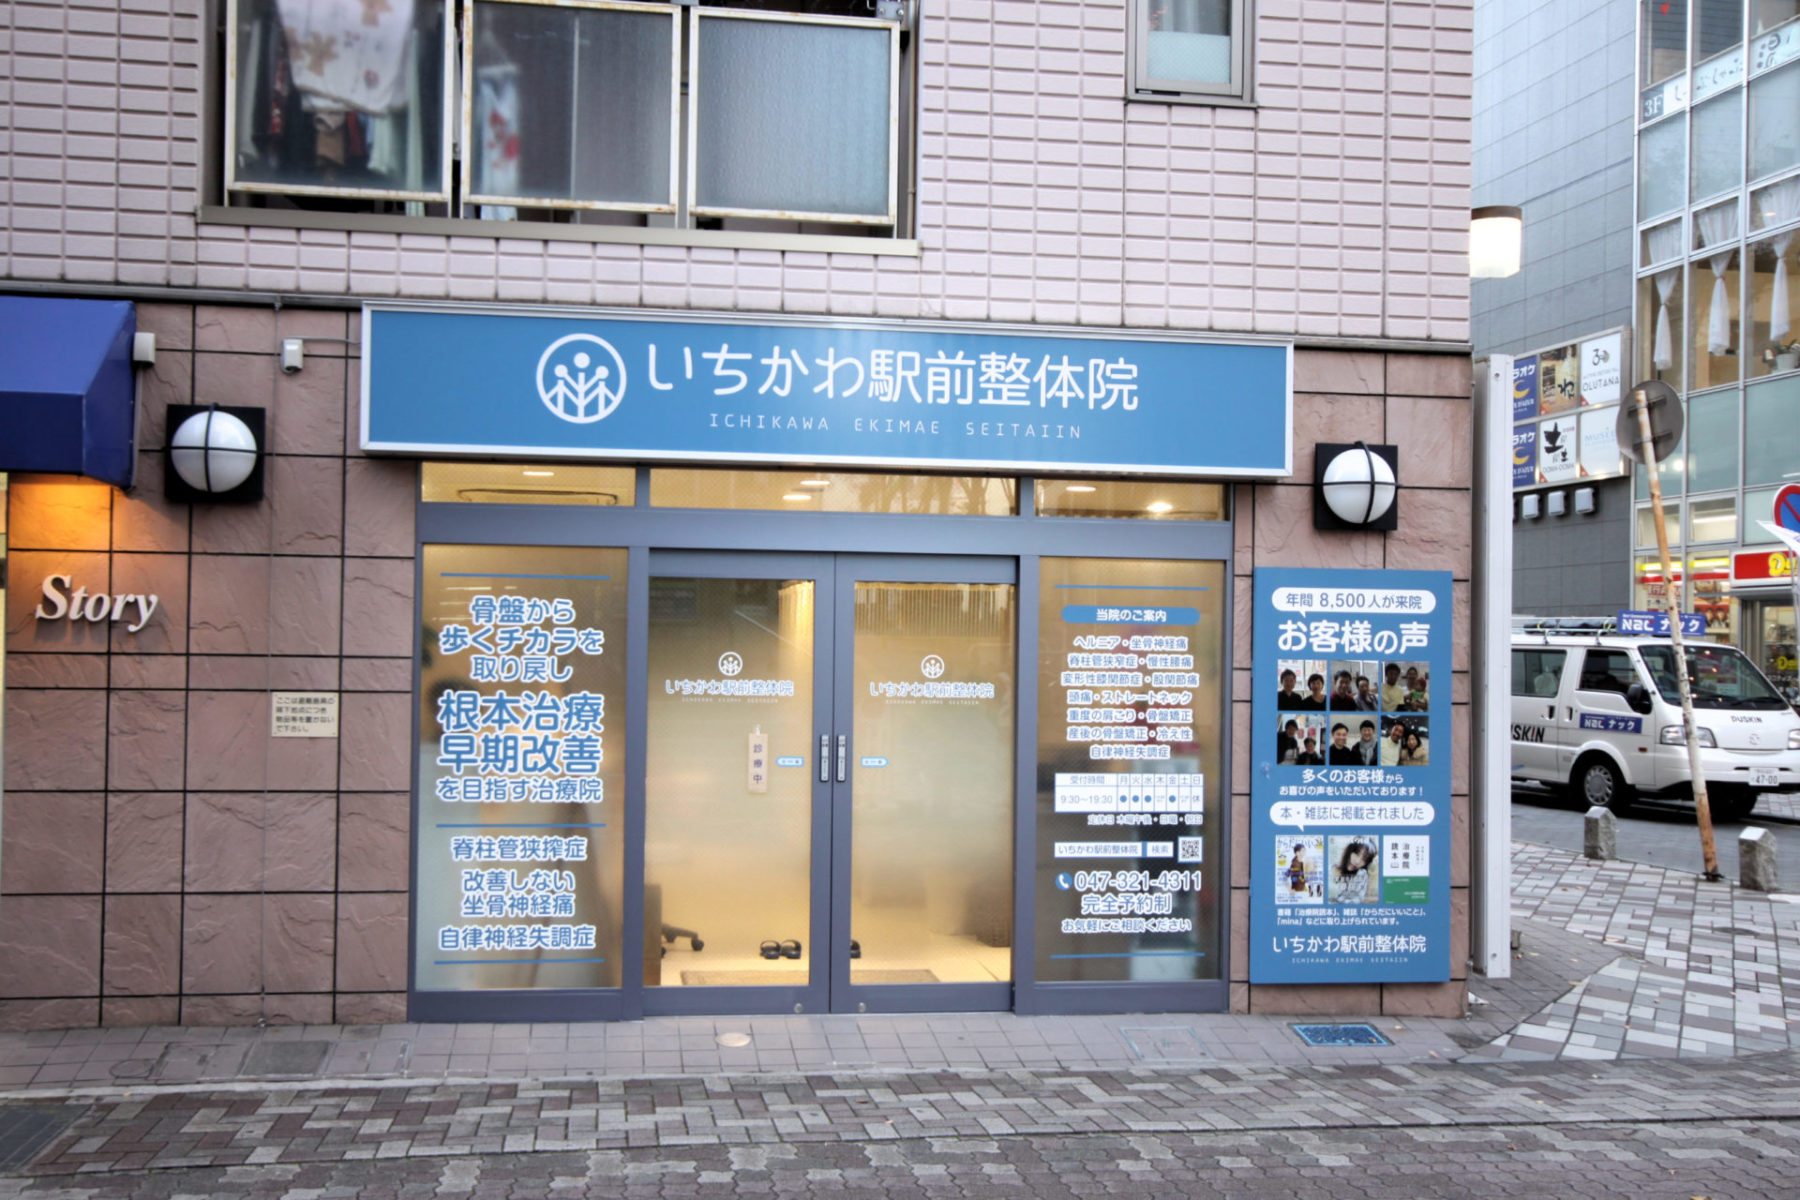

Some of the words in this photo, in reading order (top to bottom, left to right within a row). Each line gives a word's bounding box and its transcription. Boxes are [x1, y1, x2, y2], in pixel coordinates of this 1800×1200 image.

[1644, 94, 1663, 118] 3F
[648, 342, 1139, 411] いちかわ駅前整体院
[709, 413, 829, 431] ICHIKAWA
[854, 417, 940, 434] EKIMAE
[965, 421, 1080, 439] SEITAIIN
[35, 574, 159, 632] Story
[1286, 592, 1314, 608] 年間
[1319, 592, 1423, 609] 8,500人が来院
[471, 597, 576, 624] 骨盤から
[1096, 609, 1167, 622] 当院のご案内
[440, 627, 605, 655] 歩くチカラを
[1073, 635, 1188, 651] ヘルニア・坐骨神経痛
[1277, 619, 1431, 655] お客様の声
[471, 656, 574, 682] 取り戻し
[665, 679, 795, 696] いちかわ駅前整体院
[869, 681, 995, 698] いちかわ駅前整体院
[1067, 690, 1192, 704] 頭痛・ストレートネック
[437, 690, 605, 733] 根本治療
[1067, 708, 1193, 723] 重度の肩こり・骨盤矯正
[1066, 727, 1193, 742] 産後の骨盤矯正・冷え性
[1609, 720, 1635, 730] ナック
[437, 733, 602, 775] 早期改善
[1090, 745, 1171, 760] 自律神経失調症
[1070, 776, 1105, 785] 受付時間
[1120, 776, 1128, 785] 月
[1132, 776, 1141, 785] 火
[1144, 776, 1153, 785] 水
[1156, 776, 1165, 785] 木
[1169, 776, 1177, 785] 金
[1181, 776, 1190, 785] 土
[1193, 776, 1200, 784] 日
[1302, 769, 1403, 784] 多くのお客様から
[436, 777, 603, 802] を目指す治療院
[1280, 806, 1425, 821] 本・雑誌に掲載されました
[1058, 845, 1138, 854] いちかわ駅前整体院
[461, 869, 576, 892] 改善しない
[1074, 871, 1201, 891] 047-321-4311
[461, 894, 575, 917] 坐骨神経痛
[1082, 894, 1172, 914] 完全予約制
[1062, 918, 1192, 933] お気軽にご相談ください
[439, 925, 597, 950] 自律神経失調症
[1273, 935, 1427, 953] いちかわ駅前整体院
